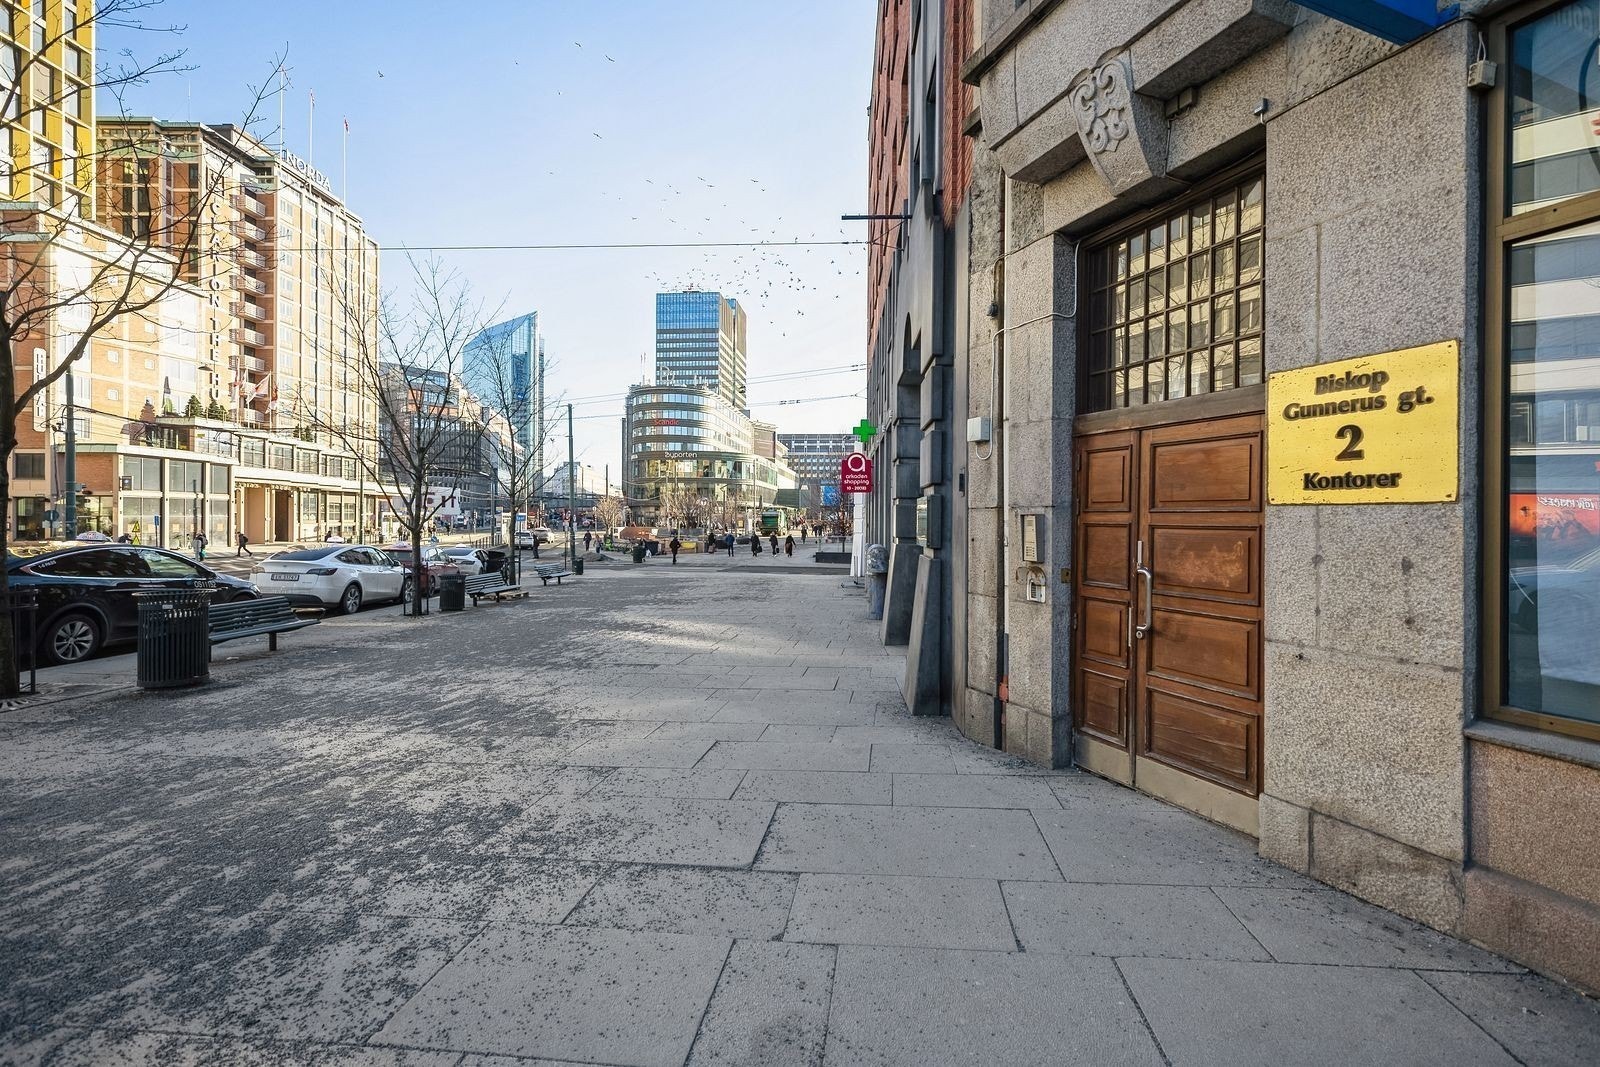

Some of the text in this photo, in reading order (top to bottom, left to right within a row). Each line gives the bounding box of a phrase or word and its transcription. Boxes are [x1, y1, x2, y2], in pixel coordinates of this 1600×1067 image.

[1314, 369, 1390, 395] Biskop
[1282, 385, 1435, 421] Gunnerus gt.
[1335, 424, 1365, 461] 2
[1303, 470, 1402, 491] Kontorer
